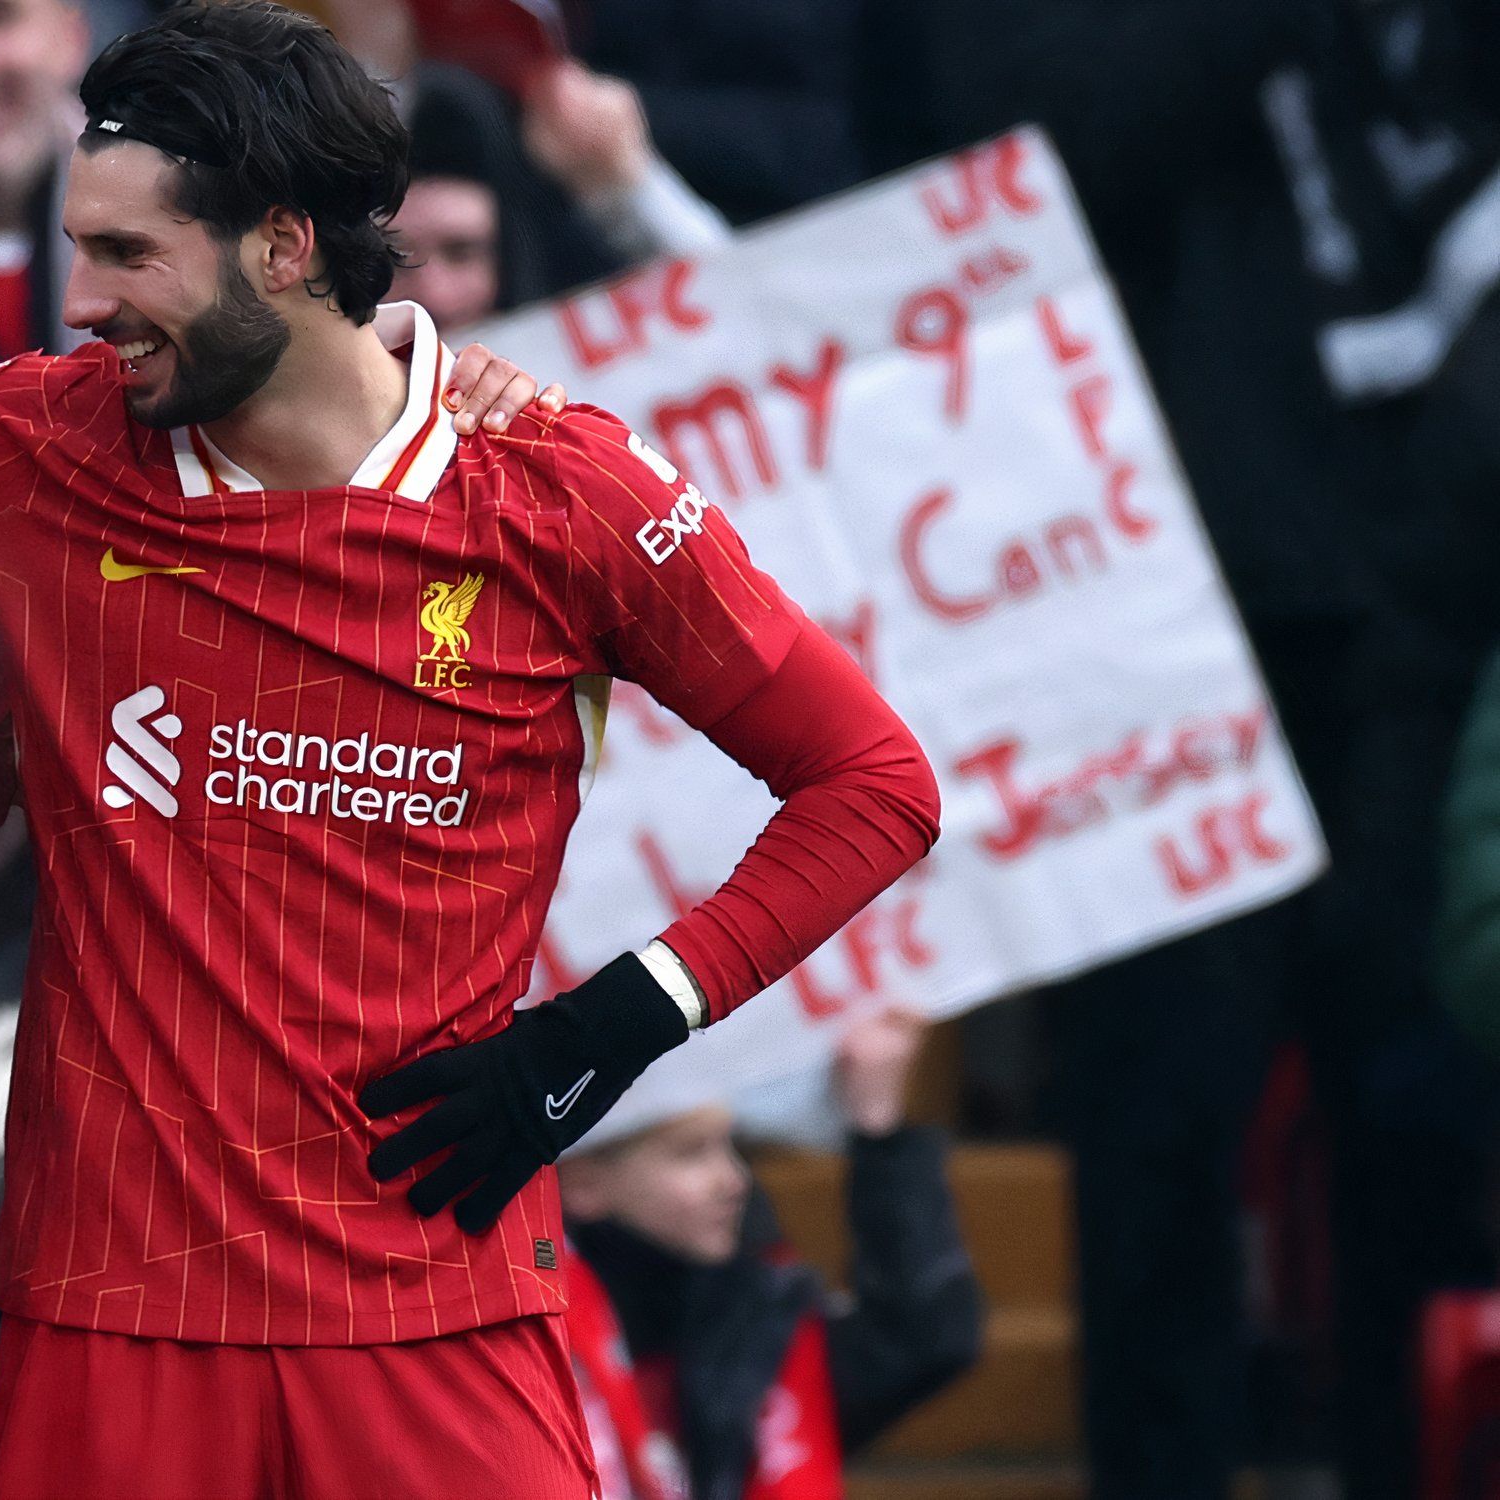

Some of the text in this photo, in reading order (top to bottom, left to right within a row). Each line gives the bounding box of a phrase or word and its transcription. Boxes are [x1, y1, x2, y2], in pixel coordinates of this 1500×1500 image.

[896, 482, 1108, 625] Can
[208, 718, 463, 786] standard
[205, 765, 470, 828] chartered
